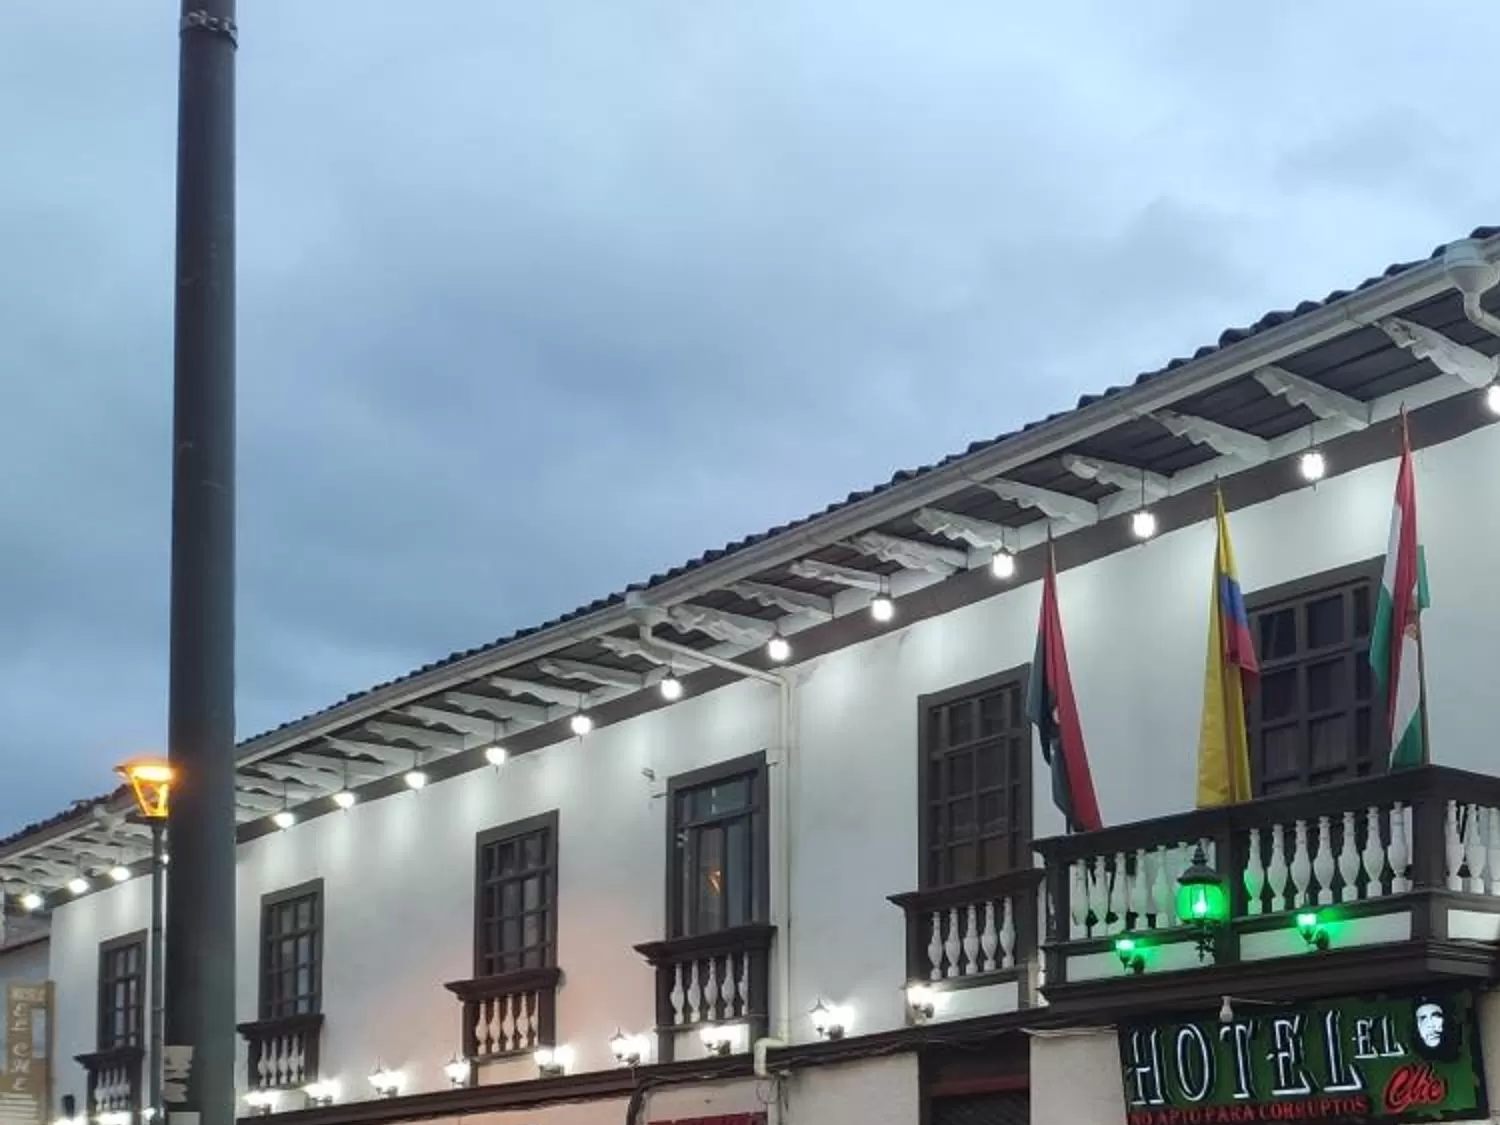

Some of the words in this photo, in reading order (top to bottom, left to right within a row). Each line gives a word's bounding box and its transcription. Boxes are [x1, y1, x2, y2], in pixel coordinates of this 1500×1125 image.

[1128, 1008, 1364, 1105] HOTEL
[1352, 1015, 1406, 1059] EL
[1156, 1107, 1201, 1125] APTO
[1204, 1103, 1255, 1124] PARA
[1259, 1097, 1368, 1120] CORRUPTOS
